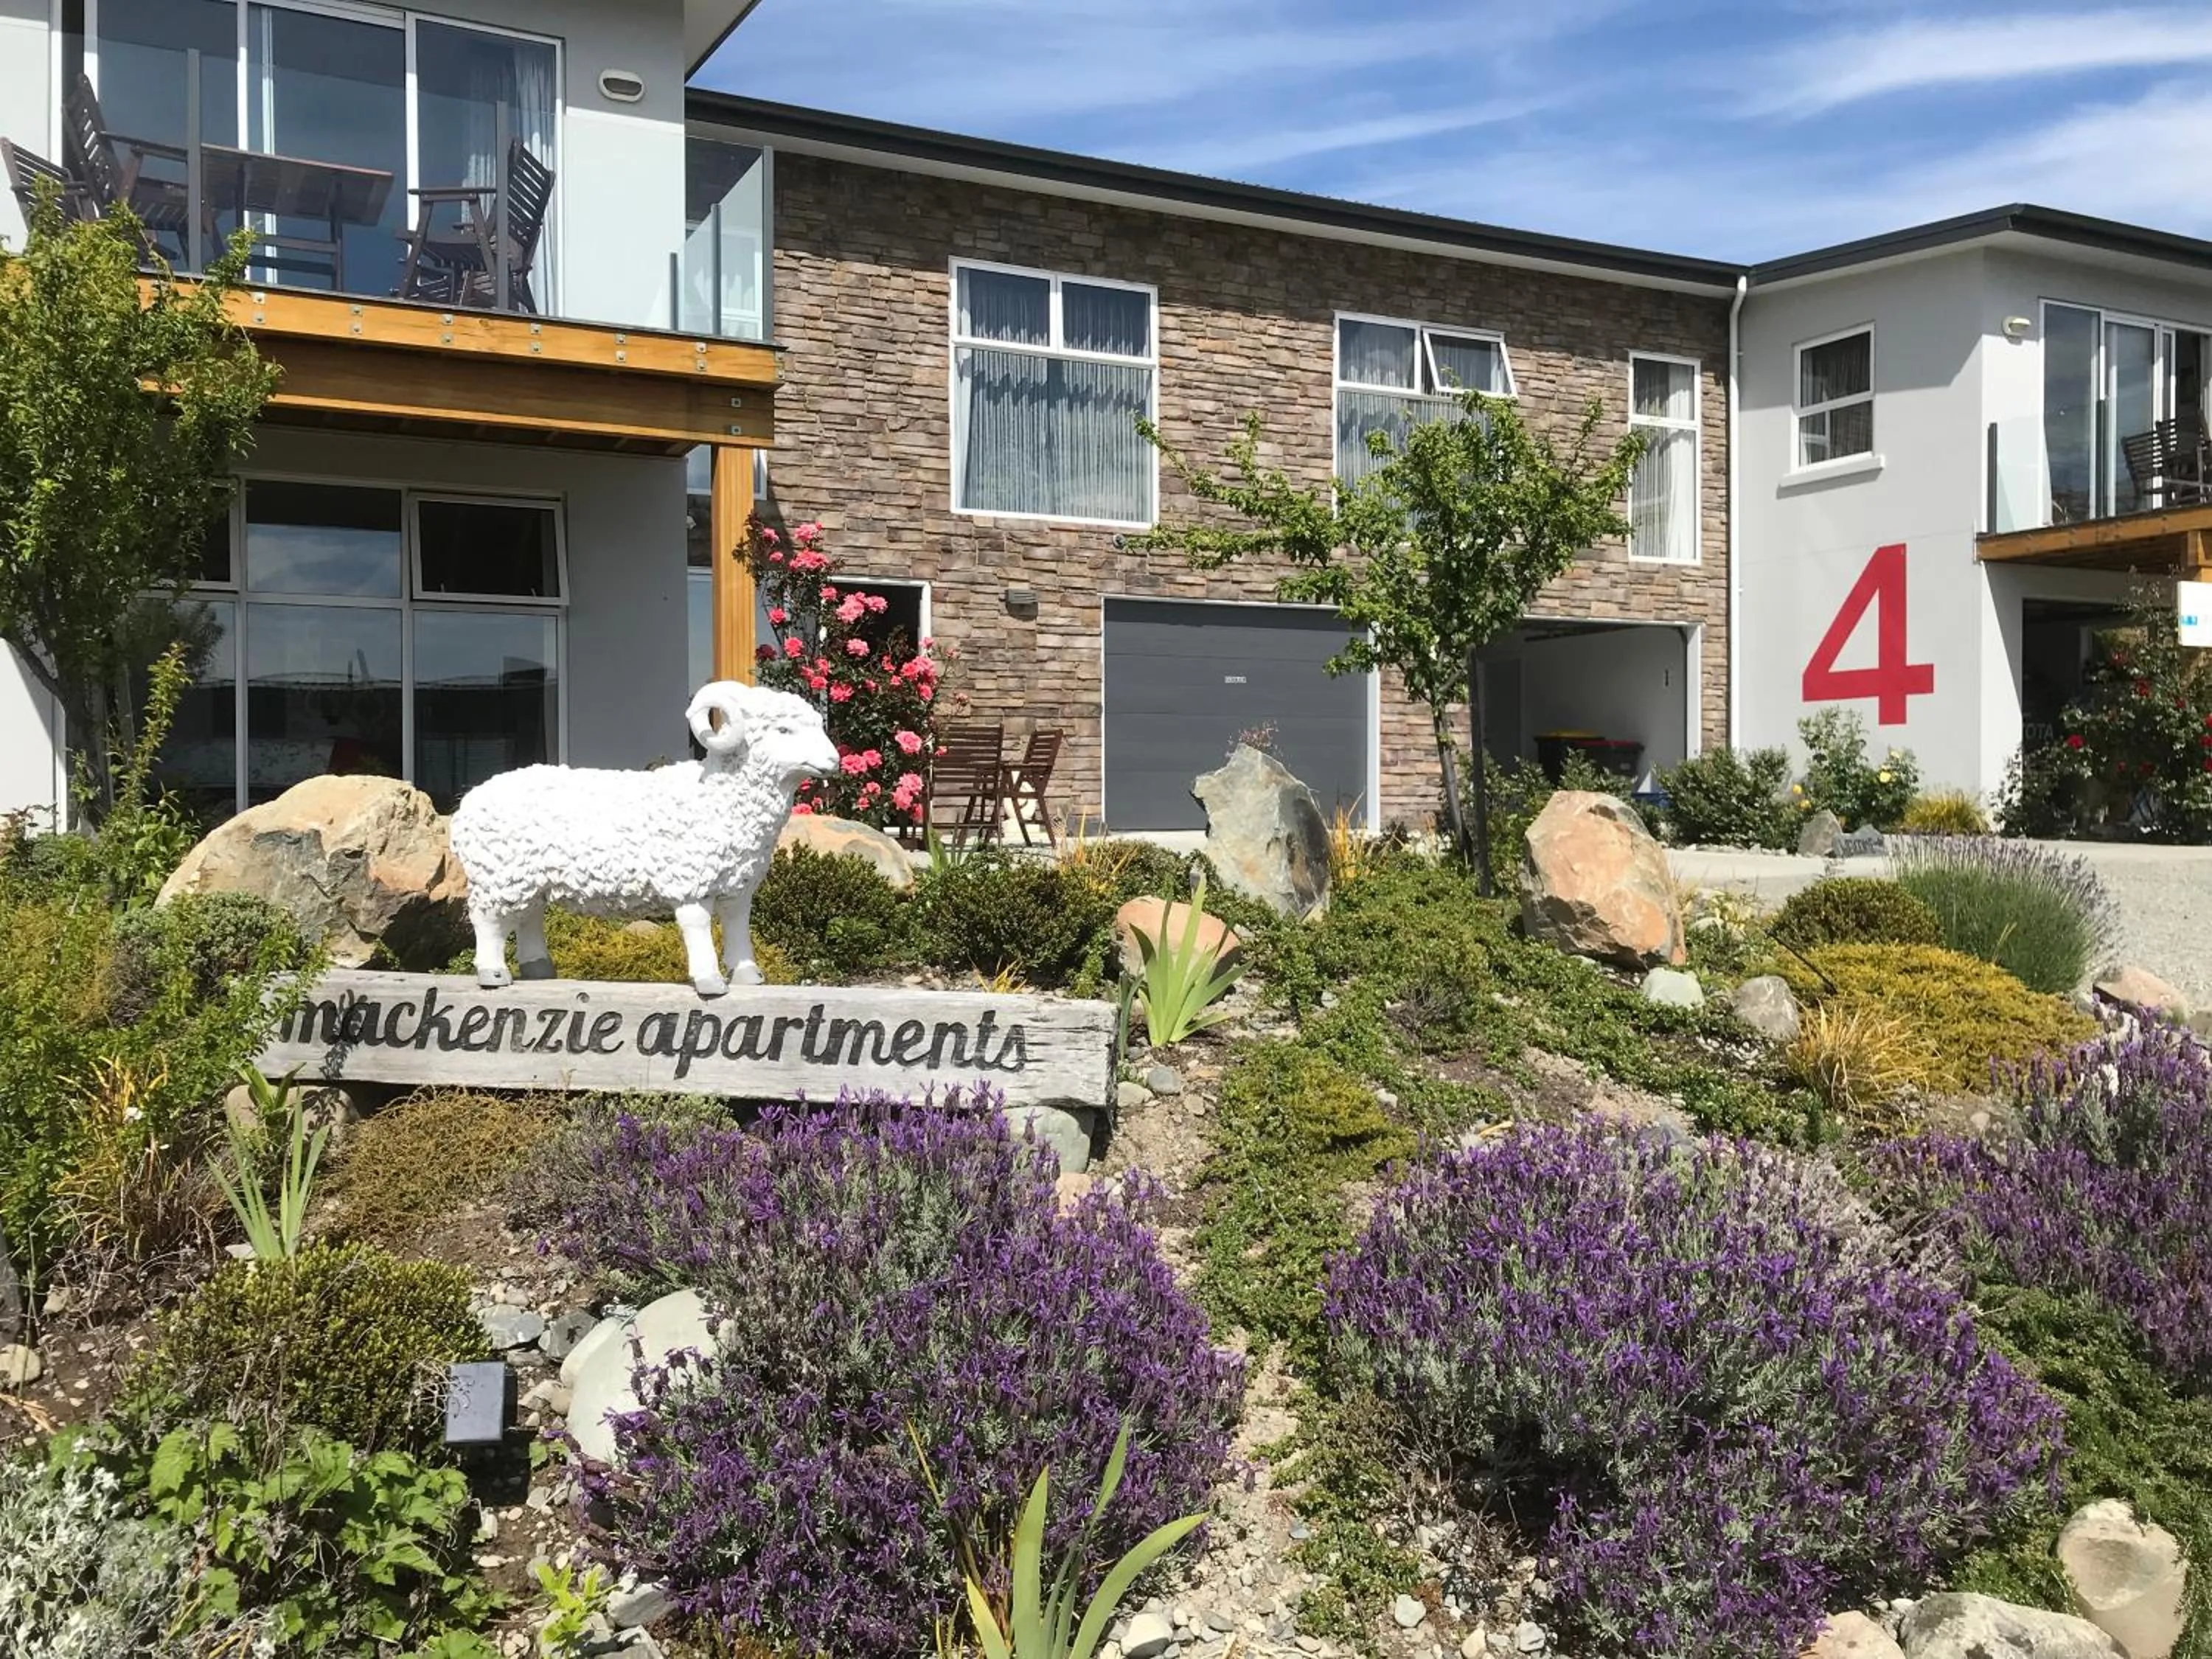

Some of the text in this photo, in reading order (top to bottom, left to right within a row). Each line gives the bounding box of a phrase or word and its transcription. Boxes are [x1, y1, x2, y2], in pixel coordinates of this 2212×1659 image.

[1802, 543, 1934, 725] 4
[2023, 723, 2054, 740] OTA
[279, 987, 1027, 1080] mackenzie apartments
